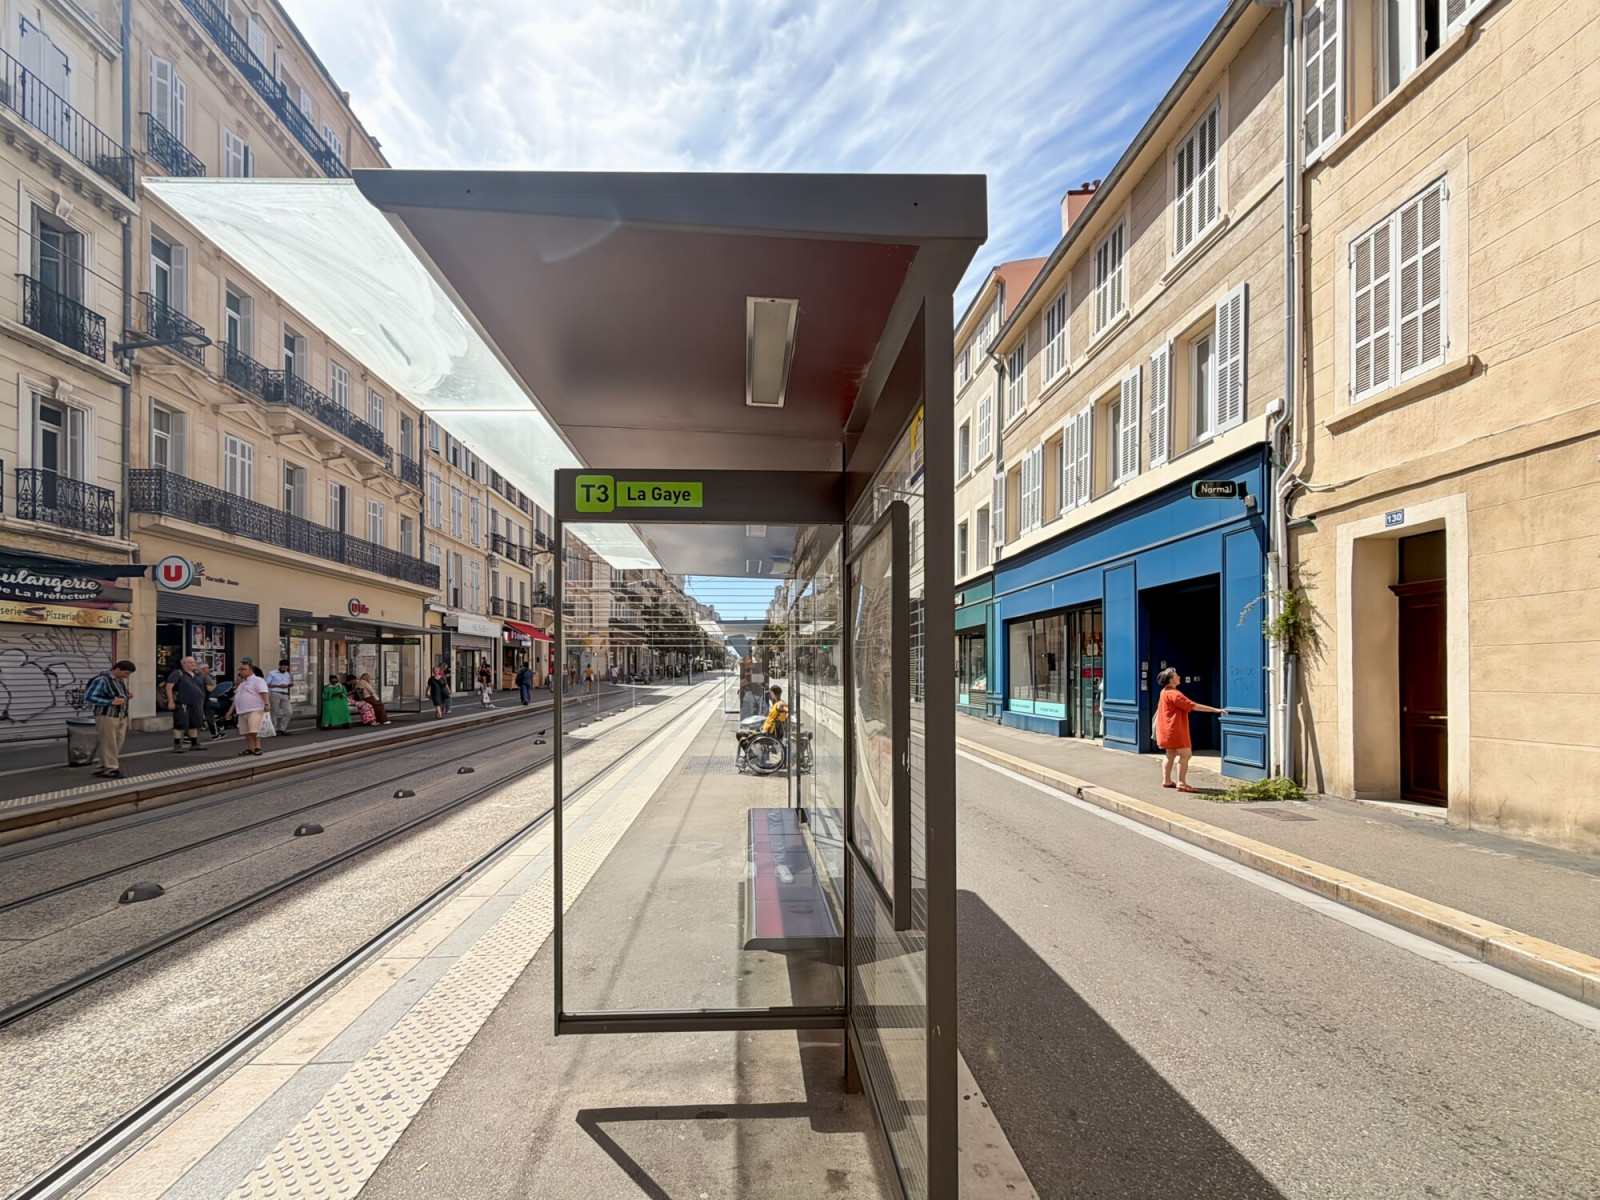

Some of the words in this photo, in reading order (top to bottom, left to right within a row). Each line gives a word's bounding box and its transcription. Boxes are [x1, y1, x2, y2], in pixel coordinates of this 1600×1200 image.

[580, 484, 610, 503] T3
[627, 486, 646, 501] La
[651, 486, 691, 505] Gaye
[1201, 483, 1233, 494] Normal
[1387, 512, 1402, 523] 130
[0, 569, 100, 593] ulangerie
[163, 565, 183, 582] U
[0, 585, 11, 594] e
[15, 588, 31, 597] La
[0, 606, 22, 616] serie
[46, 610, 76, 620] Pizzeria
[97, 615, 113, 624] Café
